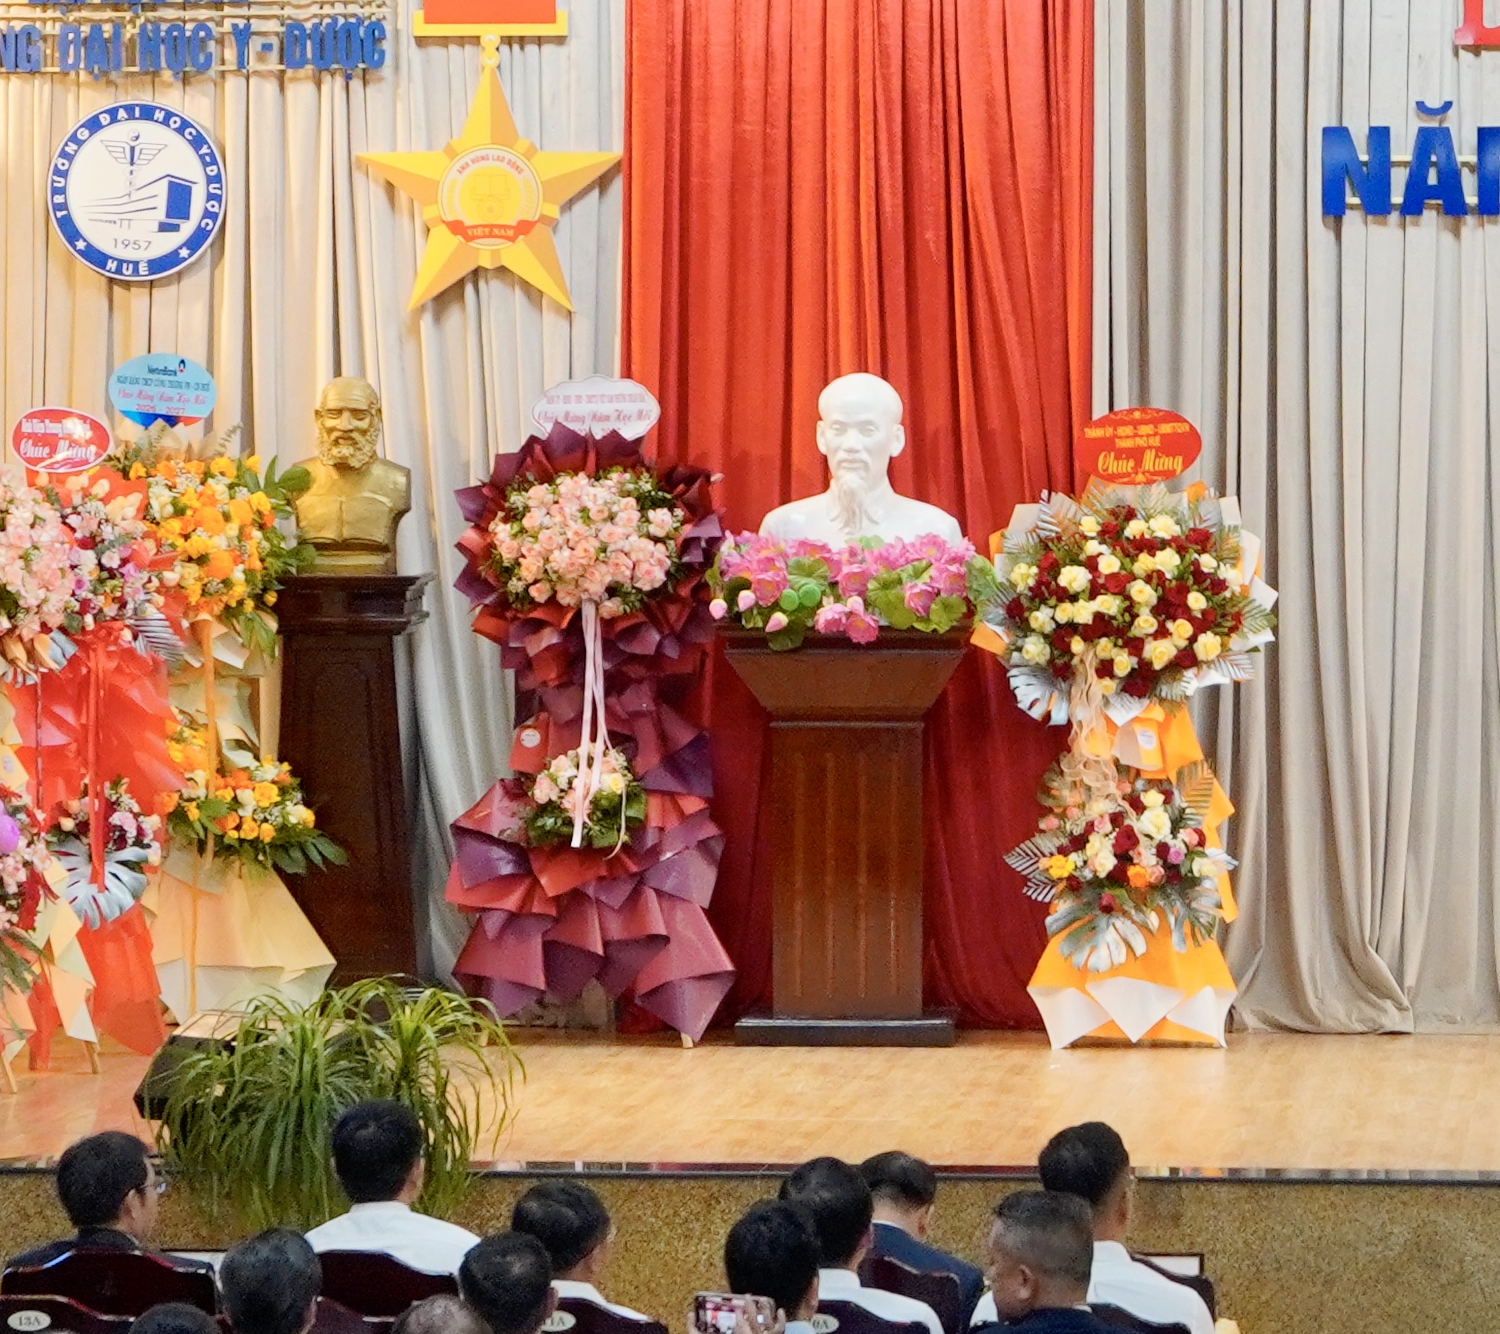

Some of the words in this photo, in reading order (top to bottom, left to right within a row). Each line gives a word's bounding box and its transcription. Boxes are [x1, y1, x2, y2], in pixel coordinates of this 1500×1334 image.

[59, 23, 122, 80] ĐẠI
[139, 22, 212, 80] HỌC
[231, 22, 252, 71] Y
[261, 43, 274, 52] -
[285, 15, 386, 80] DƯỢC
[55, 127, 89, 217] TRƯỜNG
[100, 106, 140, 126] ĐẠI
[154, 108, 197, 141] HỌC
[112, 238, 152, 251] 1957
[106, 259, 149, 275] HUẾ
[1098, 451, 1135, 474] Chúc
[1139, 449, 1183, 475] Mừng
